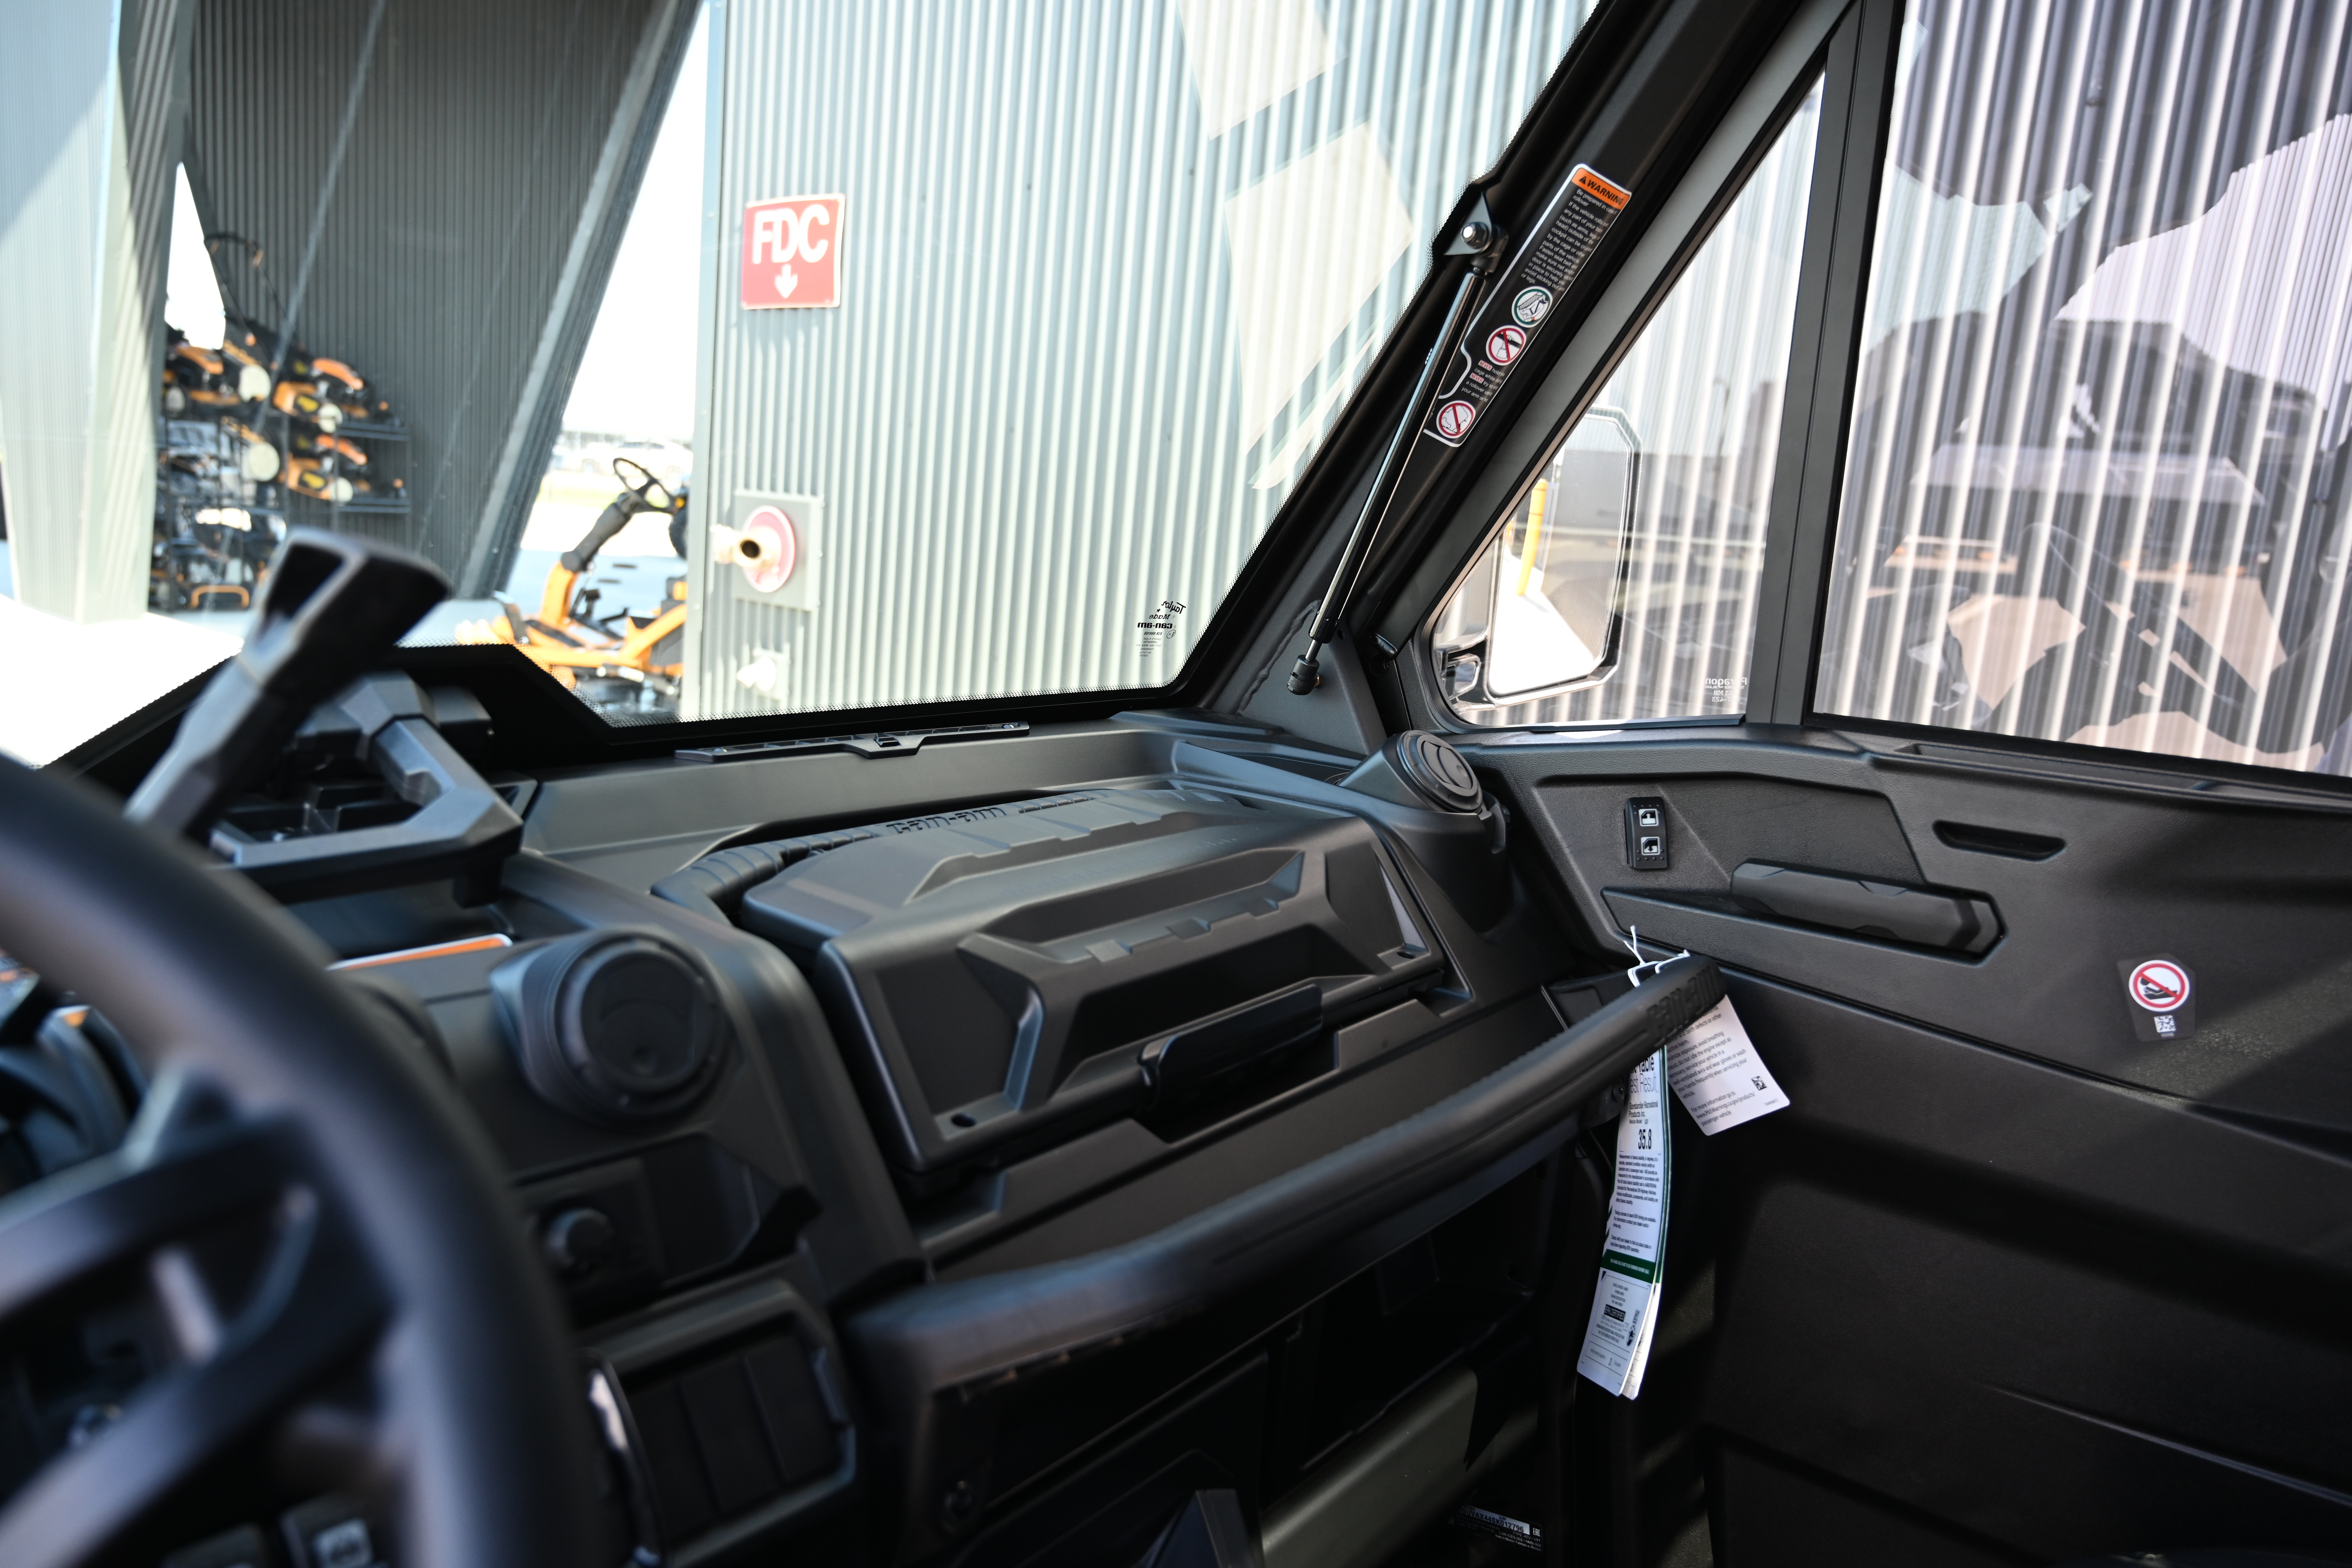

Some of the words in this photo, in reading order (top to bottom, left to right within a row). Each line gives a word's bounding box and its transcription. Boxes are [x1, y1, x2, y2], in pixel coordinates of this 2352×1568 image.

[1587, 180, 1623, 204] WARNING
[1573, 195, 1589, 206] rollover
[1582, 194, 1602, 207] prepared
[1579, 209, 1594, 220] vehicle
[1555, 220, 1568, 231] head)
[1568, 228, 1583, 239] outside
[1559, 215, 1571, 224] (such
[1577, 226, 1588, 235] arms,
[752, 204, 830, 264] FDC
[1551, 228, 1567, 239] cockpit
[1539, 245, 1554, 256] Fasten
[1542, 241, 1554, 249] parts
[1560, 242, 1571, 250] cage
[1535, 251, 1547, 261] make
[1532, 265, 1544, 273] place
[1546, 266, 1563, 278] securely
[1524, 268, 1536, 277] avoid
[1536, 275, 1552, 286] sticking
[1526, 276, 1535, 284] legs.
[1479, 361, 1491, 370] NEVER
[1470, 374, 1483, 383] NEVER
[1469, 383, 1484, 392] rollover
[1685, 1025, 1695, 1034] birth
[1694, 1019, 1707, 1030] defects
[1711, 1012, 1721, 1021] other
[1681, 1044, 1698, 1054] exposure,
[1707, 1031, 1724, 1042] breathing
[1715, 1039, 1727, 1047] except
[1673, 1071, 1698, 1085] well-ventilated
[1720, 1056, 1732, 1065] gloves
[1685, 1062, 1698, 1071] service
[1695, 1073, 1713, 1084] frequently
[1722, 1062, 1739, 1072] servicing
[1630, 1075, 1638, 1093] est
[1696, 1093, 1755, 1118] www.P65Warnings.ca.gov/products/
[1706, 1095, 1727, 1105] information
[1701, 1111, 1731, 1126] passenger-vehicle
[1638, 1129, 1652, 1149] 35.8
